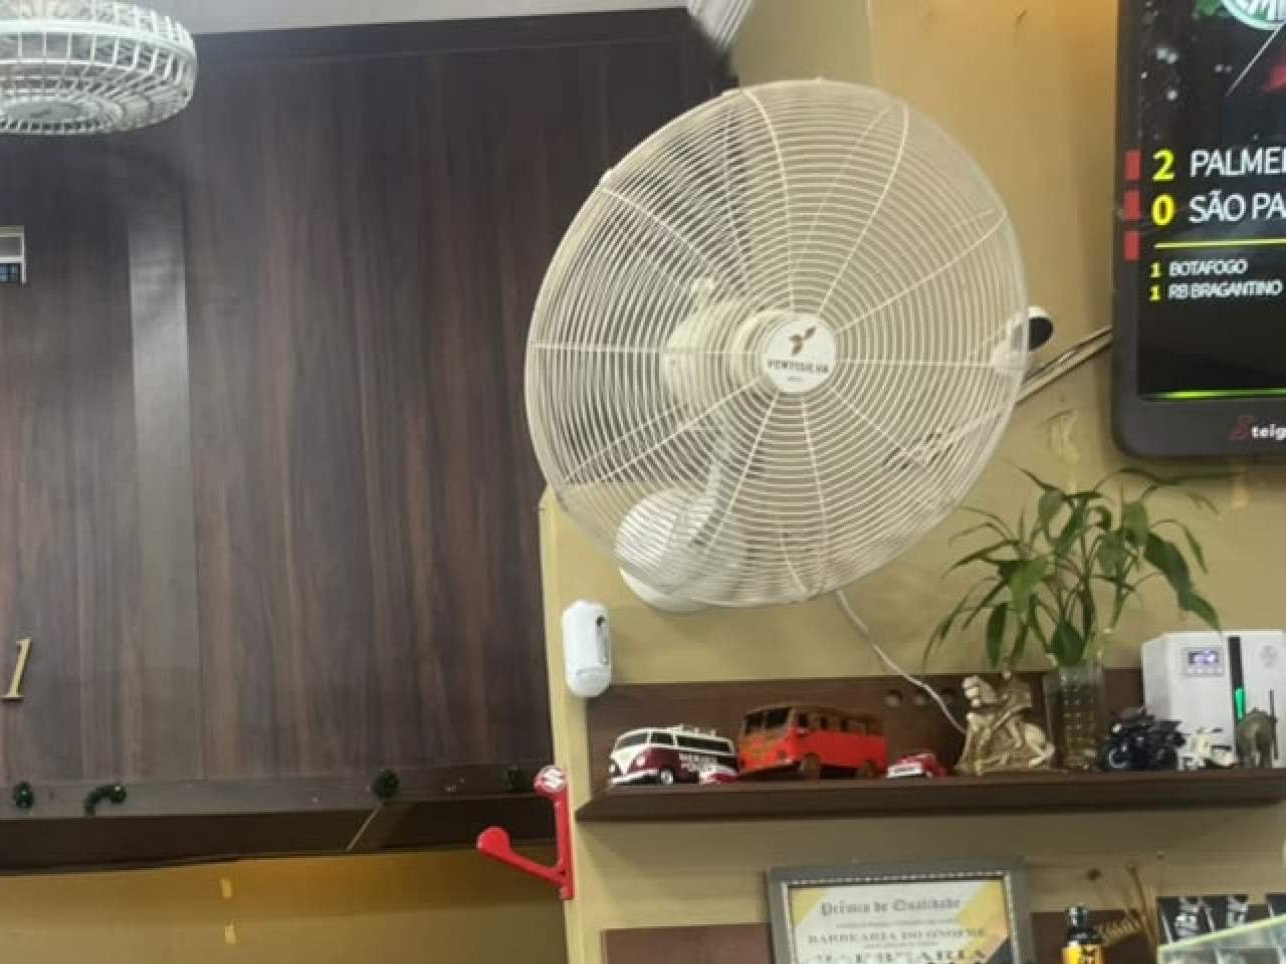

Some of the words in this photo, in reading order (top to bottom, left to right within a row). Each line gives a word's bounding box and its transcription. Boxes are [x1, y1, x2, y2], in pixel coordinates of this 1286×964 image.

[1152, 149, 1176, 182] 2
[1151, 194, 1176, 226] 0
[1188, 188, 1247, 223] SÃO
[1150, 262, 1161, 278] 1
[1168, 259, 1248, 277] BOTAFOGO
[1150, 286, 1161, 301] 1
[1168, 283, 1189, 299] RB
[1191, 279, 1283, 299] BRAGANTINO
